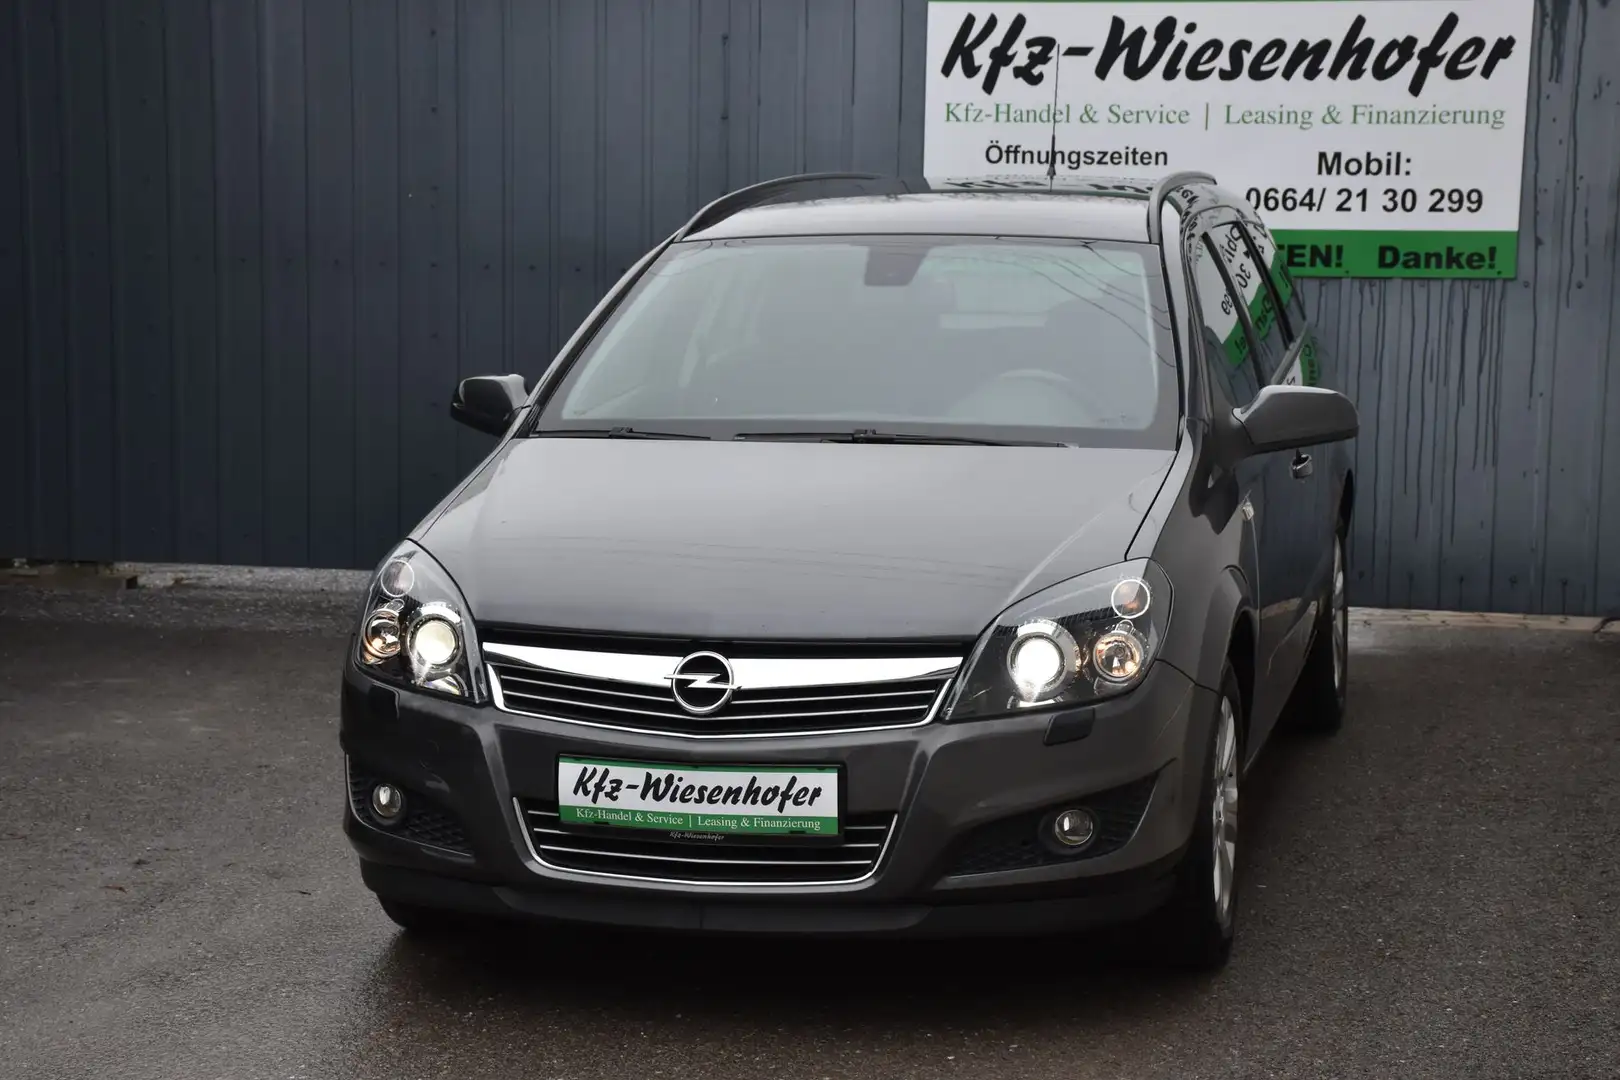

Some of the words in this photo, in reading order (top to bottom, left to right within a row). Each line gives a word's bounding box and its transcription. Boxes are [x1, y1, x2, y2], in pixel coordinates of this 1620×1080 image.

[941, 11, 1516, 98] Kfz-Wiesenhofer
[944, 102, 1071, 124] Kfz-Handel
[1079, 103, 1099, 124] &
[1107, 103, 1190, 124] Service
[1225, 104, 1313, 131] Leasing
[1321, 104, 1343, 125] &
[1351, 104, 1506, 131] Finanzierung
[985, 140, 1168, 170] Öffnungszeiten
[1317, 151, 1411, 176] Mobil:
[1246, 187, 1327, 212] 0664/
[1336, 187, 1368, 212] 21
[1382, 187, 1417, 213] 30
[1428, 187, 1484, 213] 299
[1378, 245, 1497, 270] Danke!
[573, 766, 822, 813] Kfz-Wiesenhofer
[576, 808, 633, 821] Kfz-Handel
[634, 812, 645, 823] &
[647, 812, 684, 825] Service
[697, 816, 738, 829] Leasing
[740, 816, 750, 827] &
[753, 817, 821, 831] Finanzierung
[669, 831, 725, 841] Kfz-Wiesenhofer
